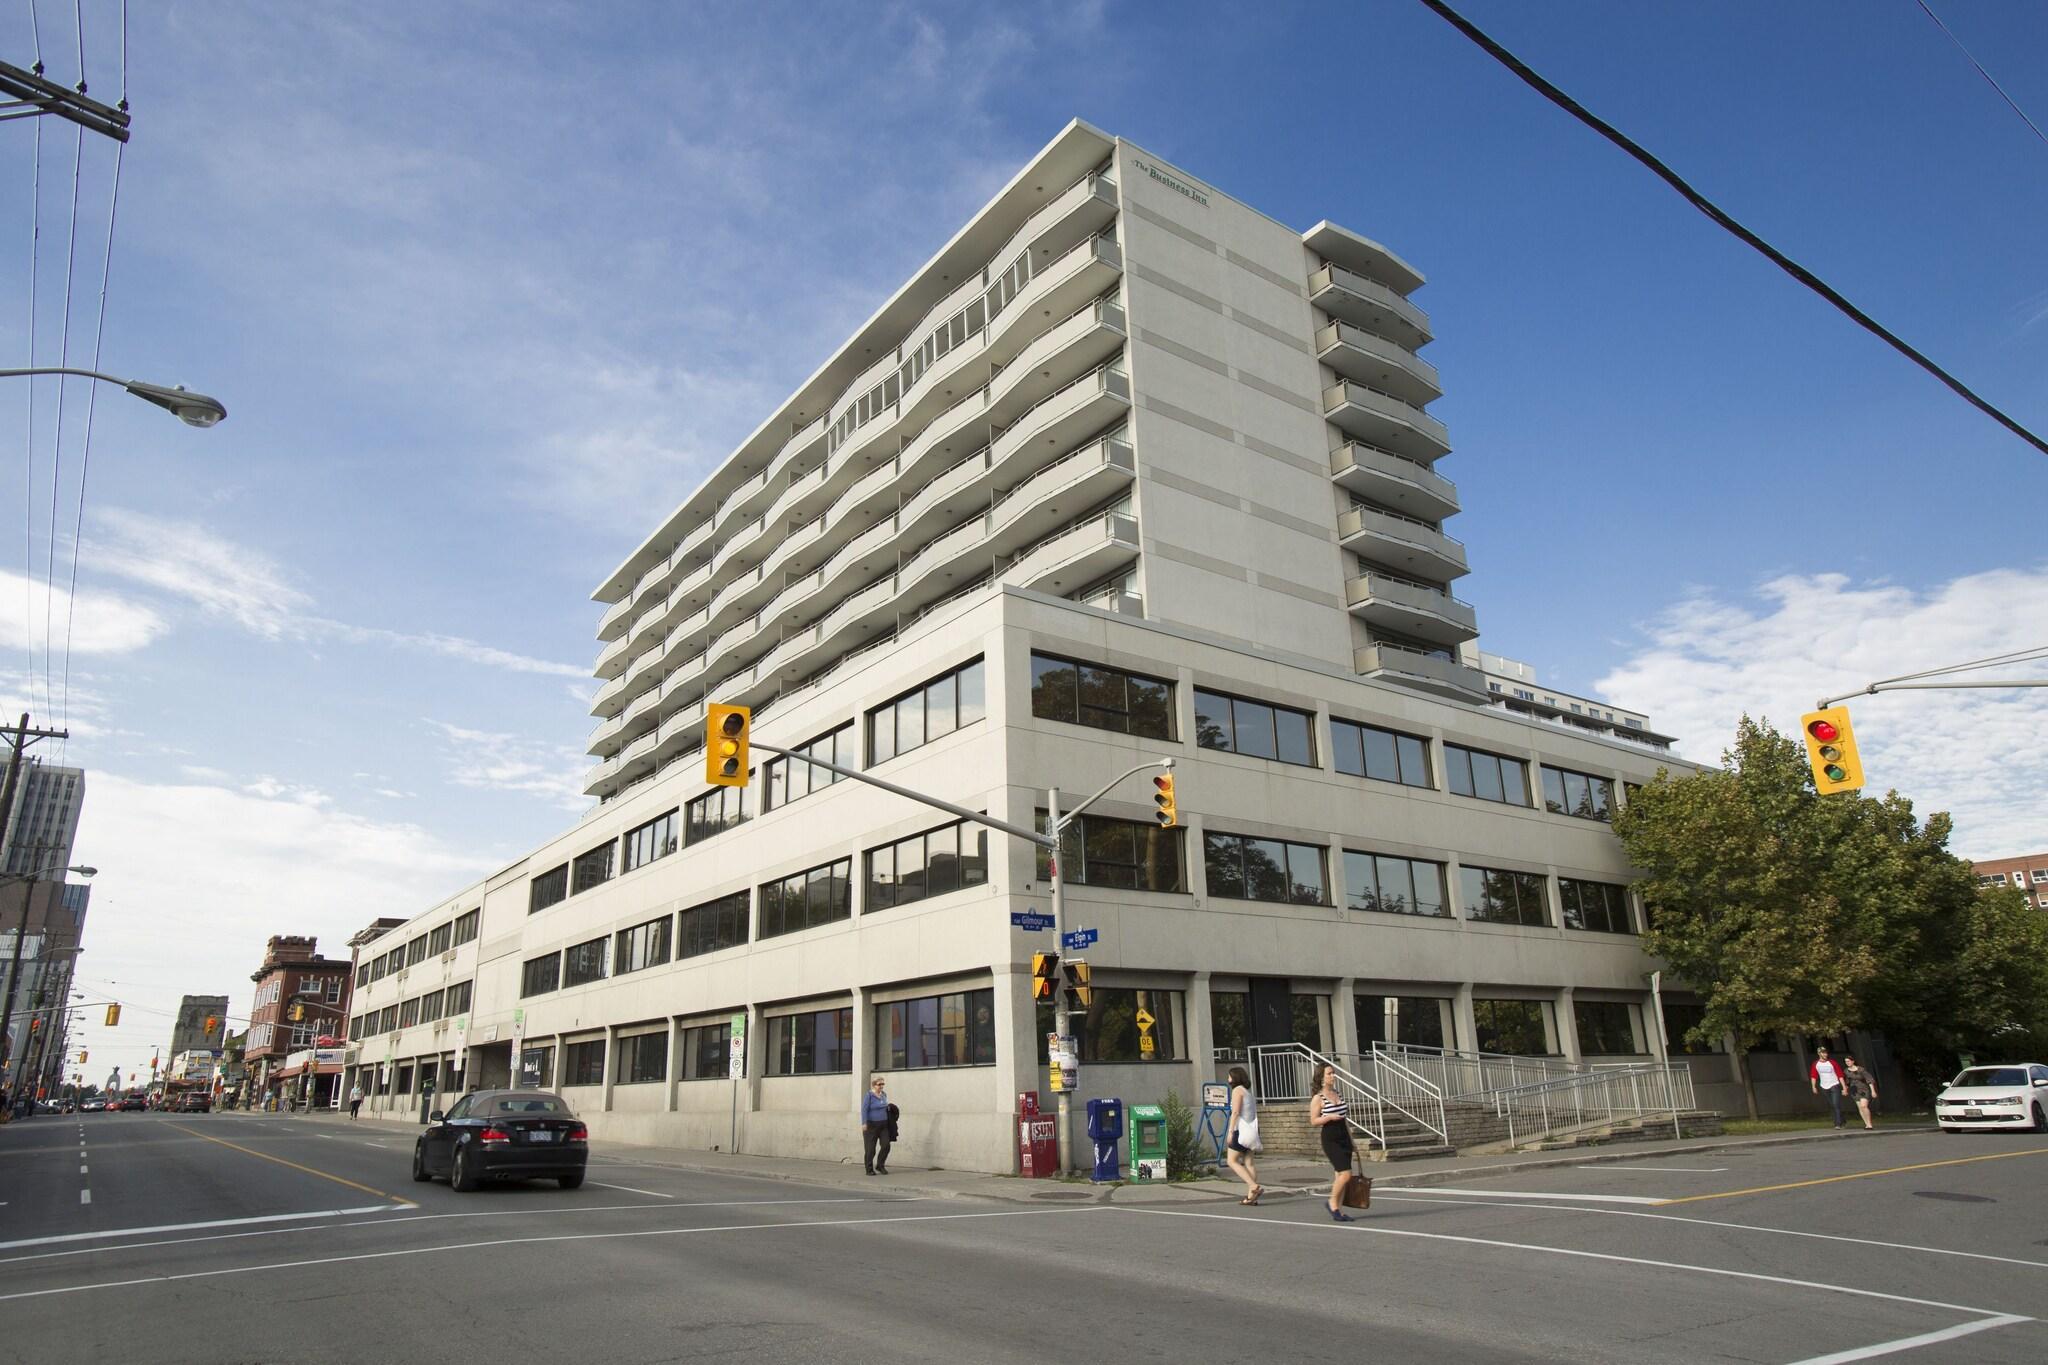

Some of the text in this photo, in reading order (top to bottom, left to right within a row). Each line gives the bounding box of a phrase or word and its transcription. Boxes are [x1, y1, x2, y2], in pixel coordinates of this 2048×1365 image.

[1134, 159, 1207, 205] The Business Inn
[1035, 1123, 1053, 1137] SUN
